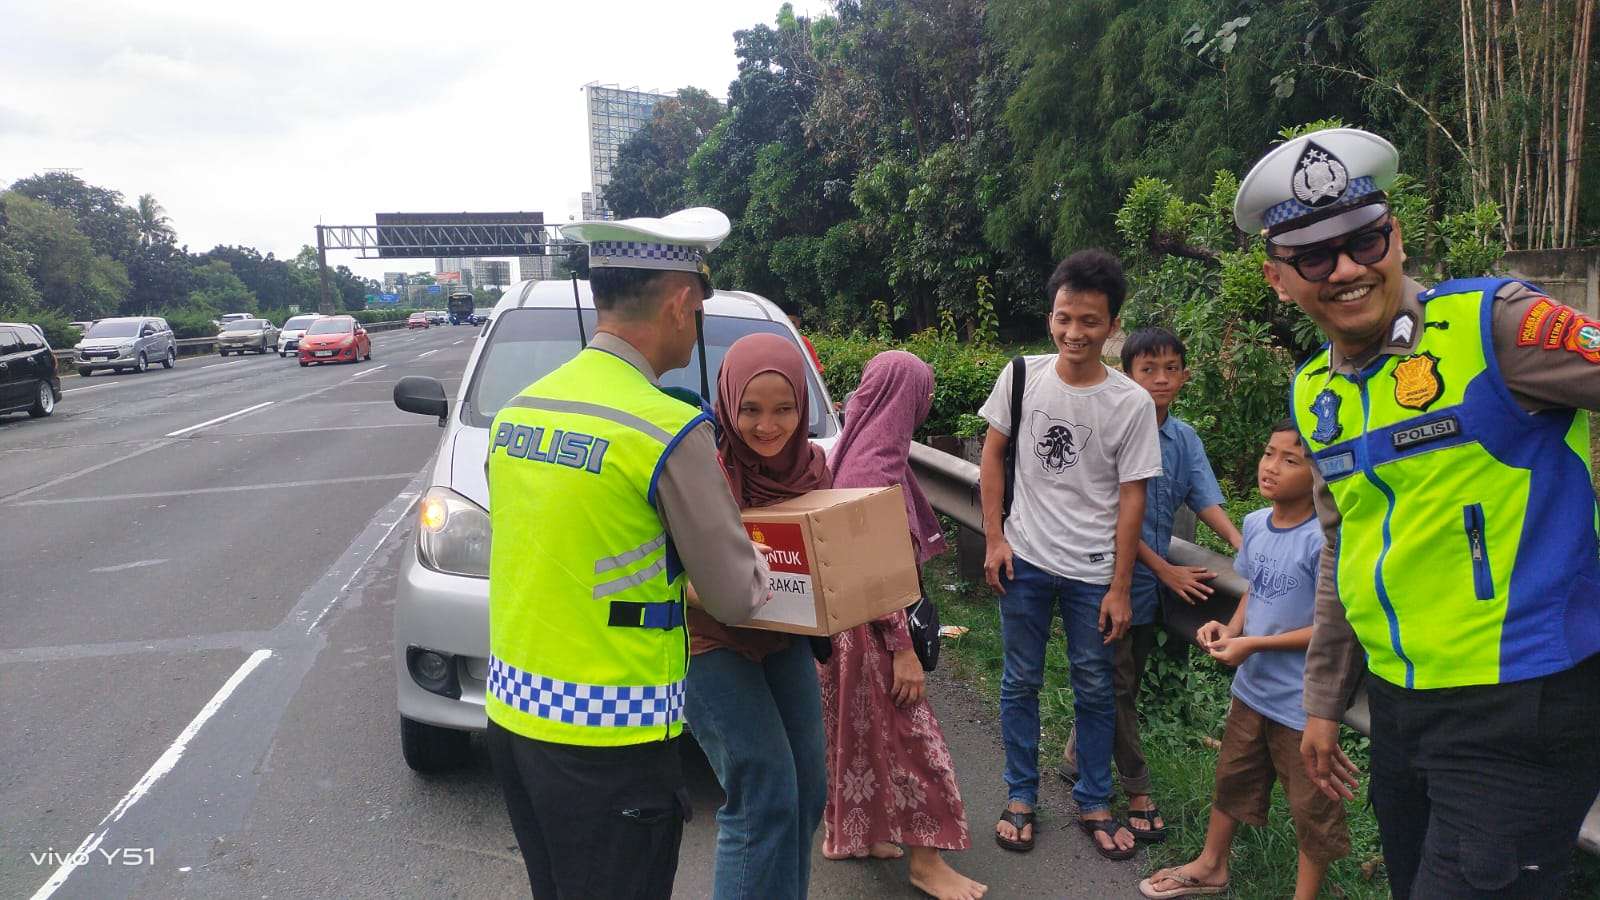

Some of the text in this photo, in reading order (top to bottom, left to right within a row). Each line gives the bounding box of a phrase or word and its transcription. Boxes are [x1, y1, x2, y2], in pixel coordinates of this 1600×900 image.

[1548, 322, 1562, 345] METRO
[1397, 419, 1453, 444] POLISI
[491, 422, 610, 475] POLISI
